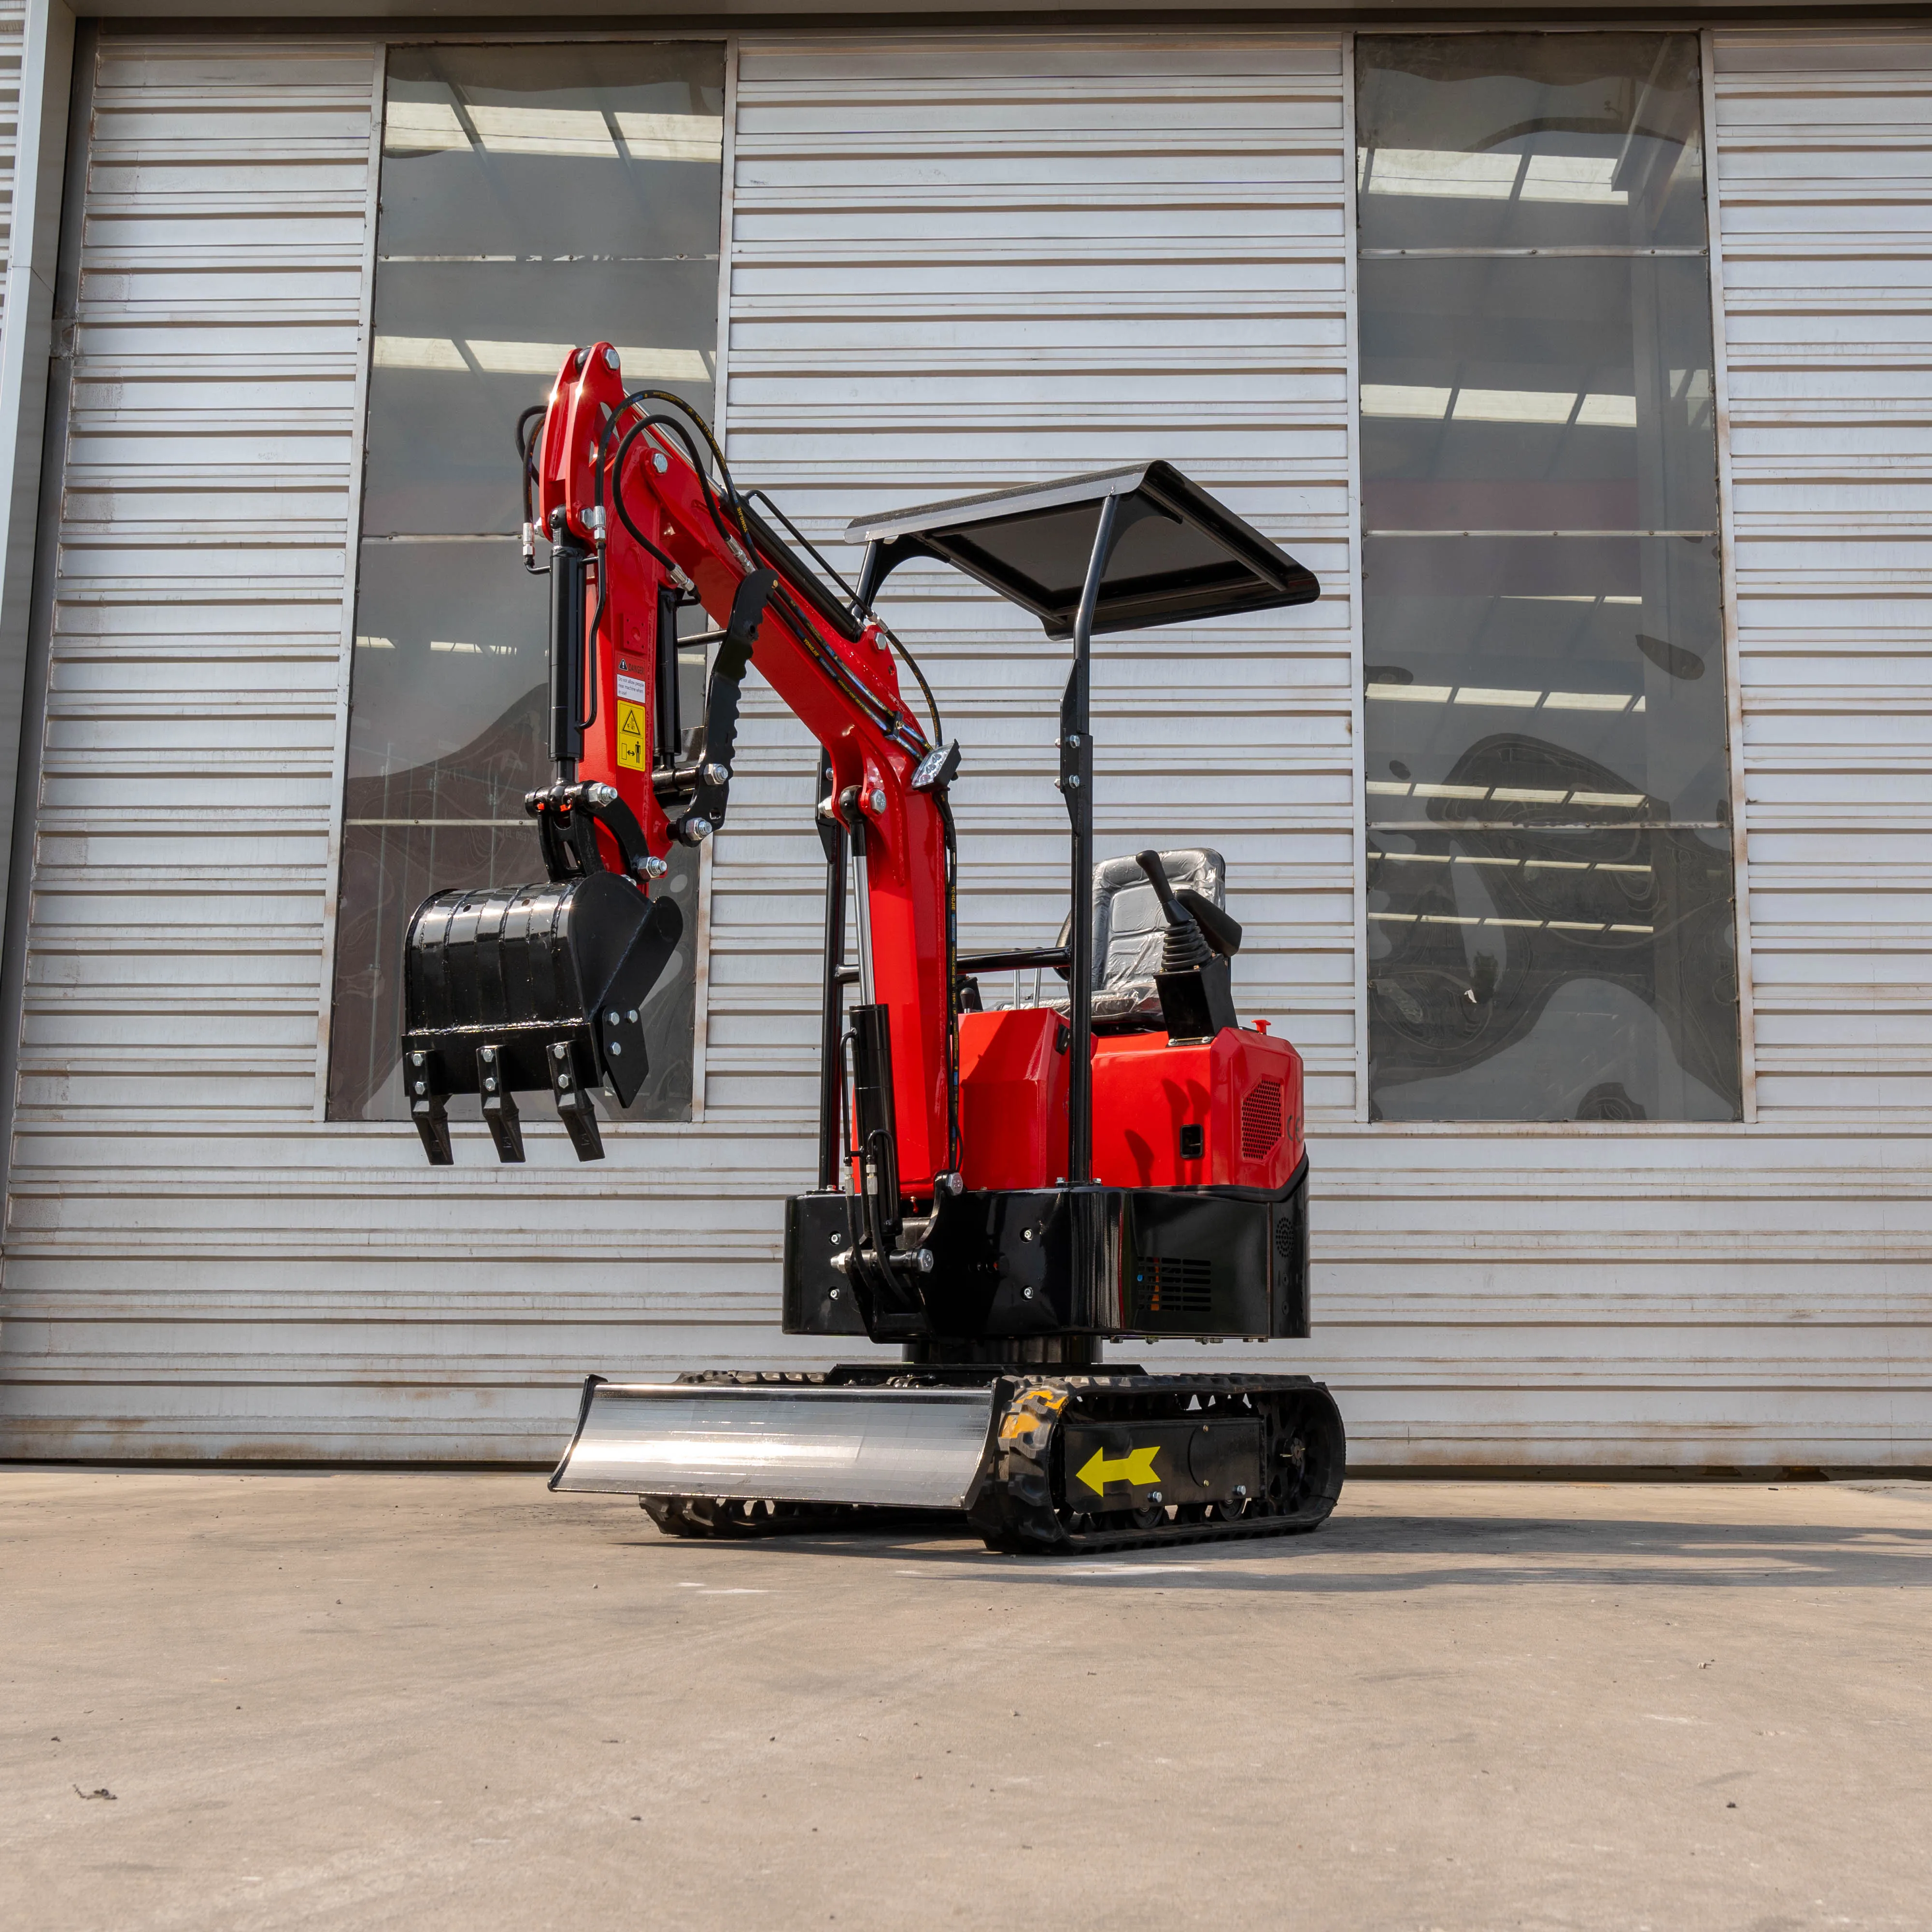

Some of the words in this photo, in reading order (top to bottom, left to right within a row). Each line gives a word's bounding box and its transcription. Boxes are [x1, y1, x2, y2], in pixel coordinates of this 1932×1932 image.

[737, 506, 748, 533] YONGJIE
[803, 638, 820, 656] YONGJIE
[1287, 1115, 1301, 1143] CE
